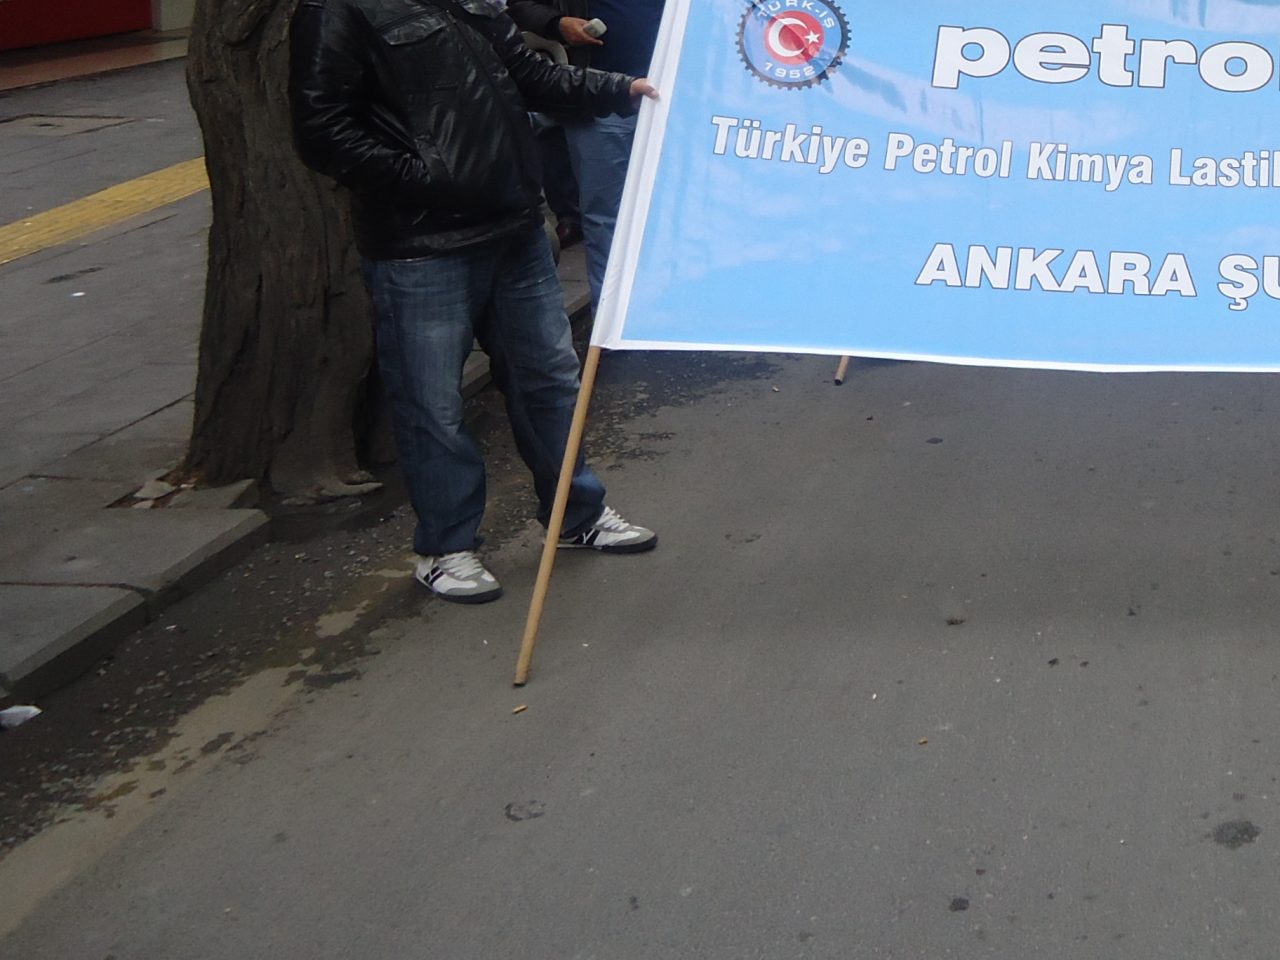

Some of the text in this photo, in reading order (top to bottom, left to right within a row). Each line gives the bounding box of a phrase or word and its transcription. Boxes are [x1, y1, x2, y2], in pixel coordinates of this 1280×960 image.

[764, 61, 816, 78] 1952
[711, 116, 869, 174] Türkiye
[884, 132, 1012, 178] Petrol
[1026, 143, 1153, 191] Kimya
[915, 242, 1197, 297] ANKARA
